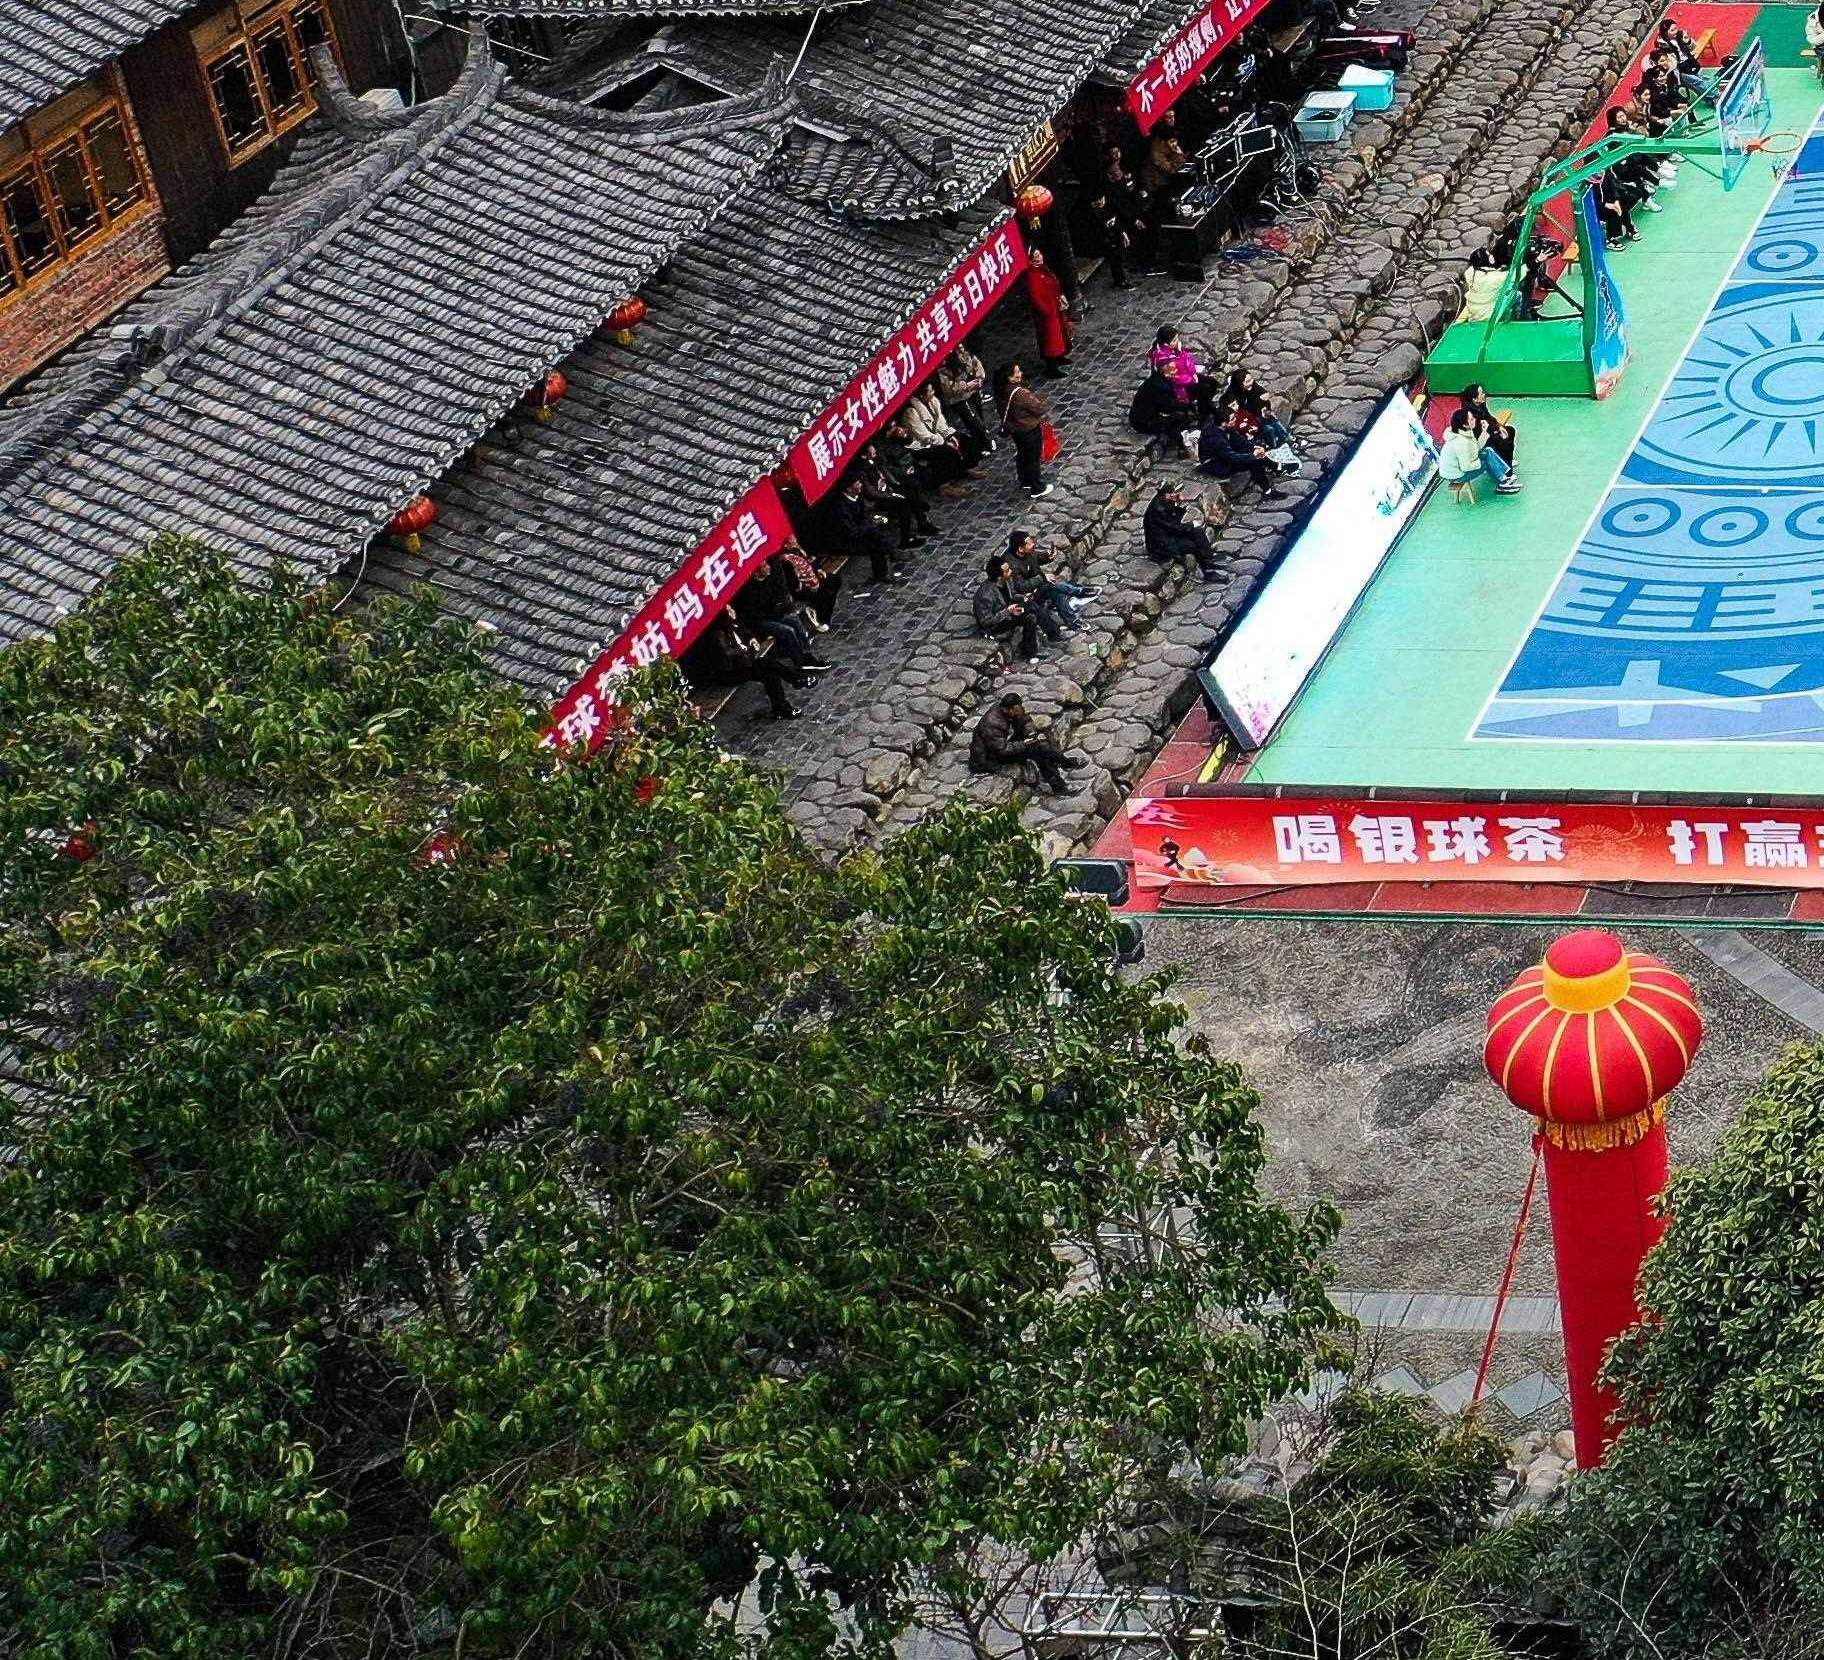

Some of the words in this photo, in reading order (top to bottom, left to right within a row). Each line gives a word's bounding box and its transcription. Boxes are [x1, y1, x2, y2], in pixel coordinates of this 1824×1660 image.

[807, 346, 919, 480] 展示女性魅力
[917, 233, 1015, 364] 共享节日快乐
[540, 508, 769, 751] 球梦姑妈在追
[1272, 814, 1567, 867] 喝银球茶
